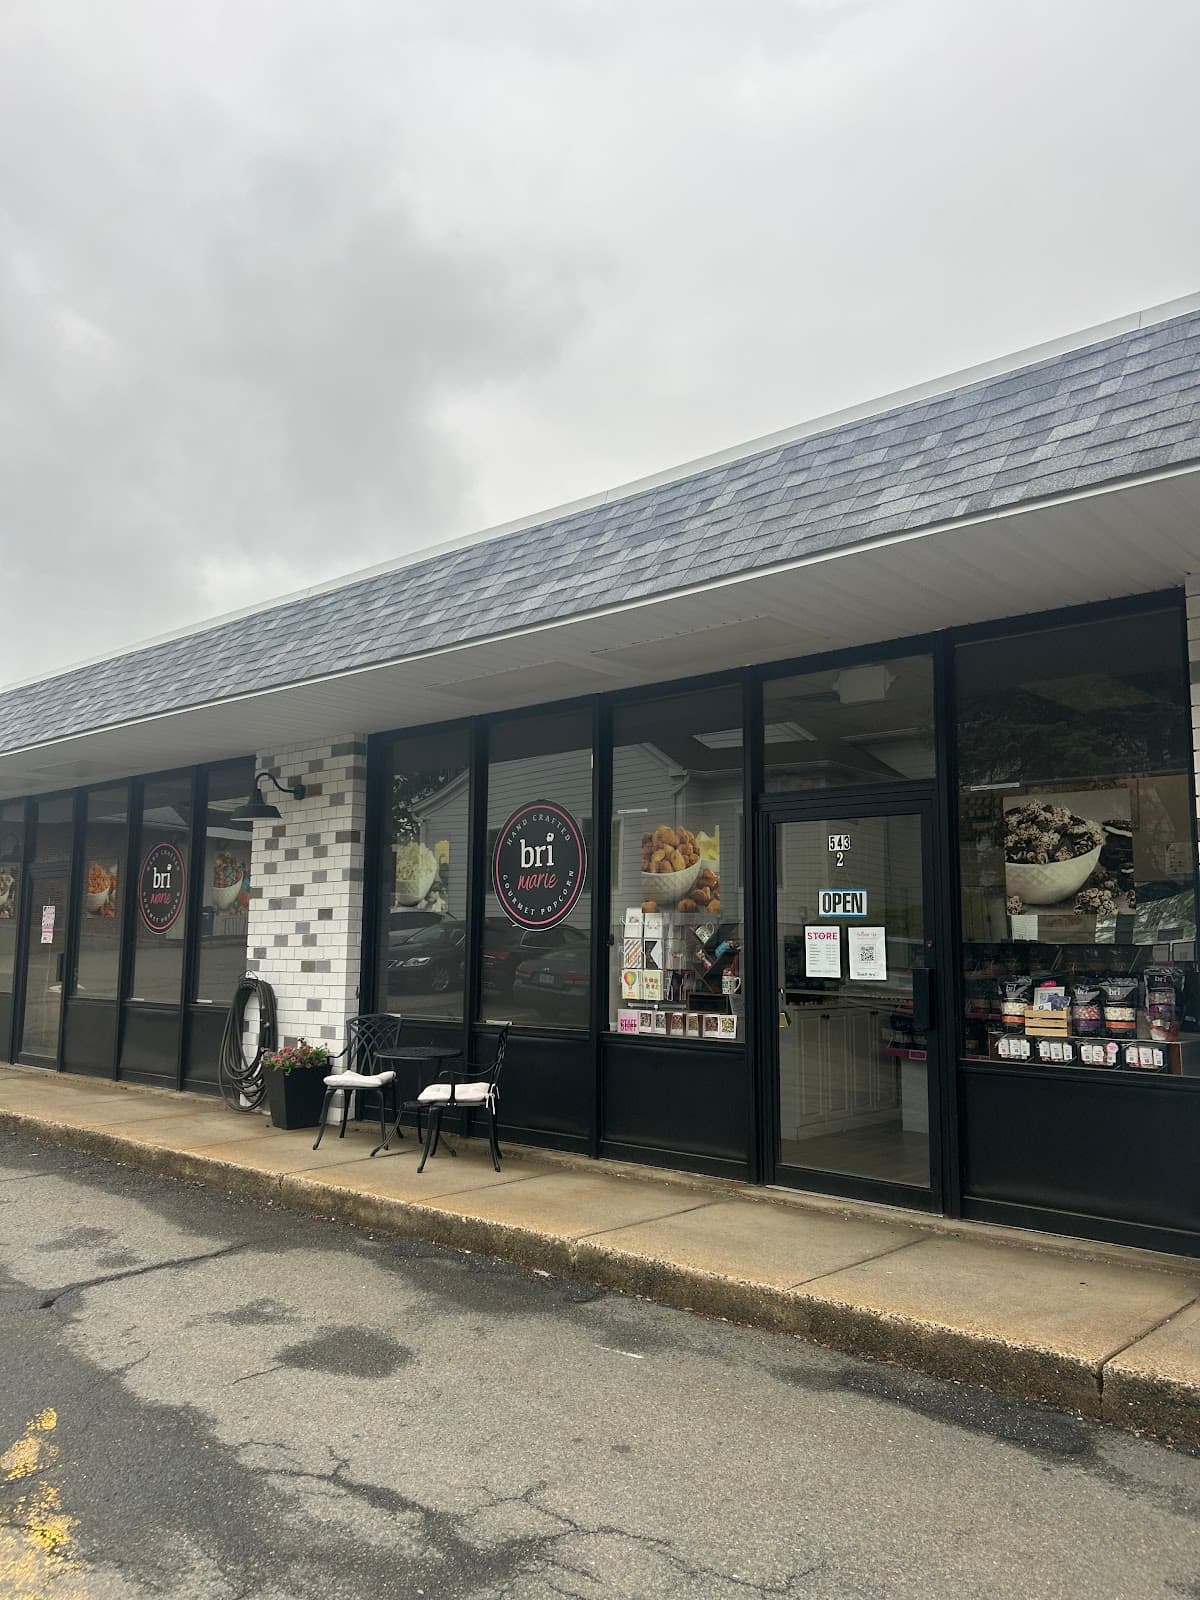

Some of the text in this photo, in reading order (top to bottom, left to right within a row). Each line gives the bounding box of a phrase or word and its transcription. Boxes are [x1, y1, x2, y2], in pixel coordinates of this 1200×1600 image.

[507, 814, 571, 846] HAND CRAFTED
[520, 832, 555, 868] bri
[829, 835, 850, 850] 543
[836, 851, 844, 867] 2
[153, 863, 172, 889] bri
[517, 872, 558, 891] marie
[502, 870, 575, 915] GOURMET POPCORN
[822, 892, 863, 914] OPEN
[807, 932, 838, 941] STORE
